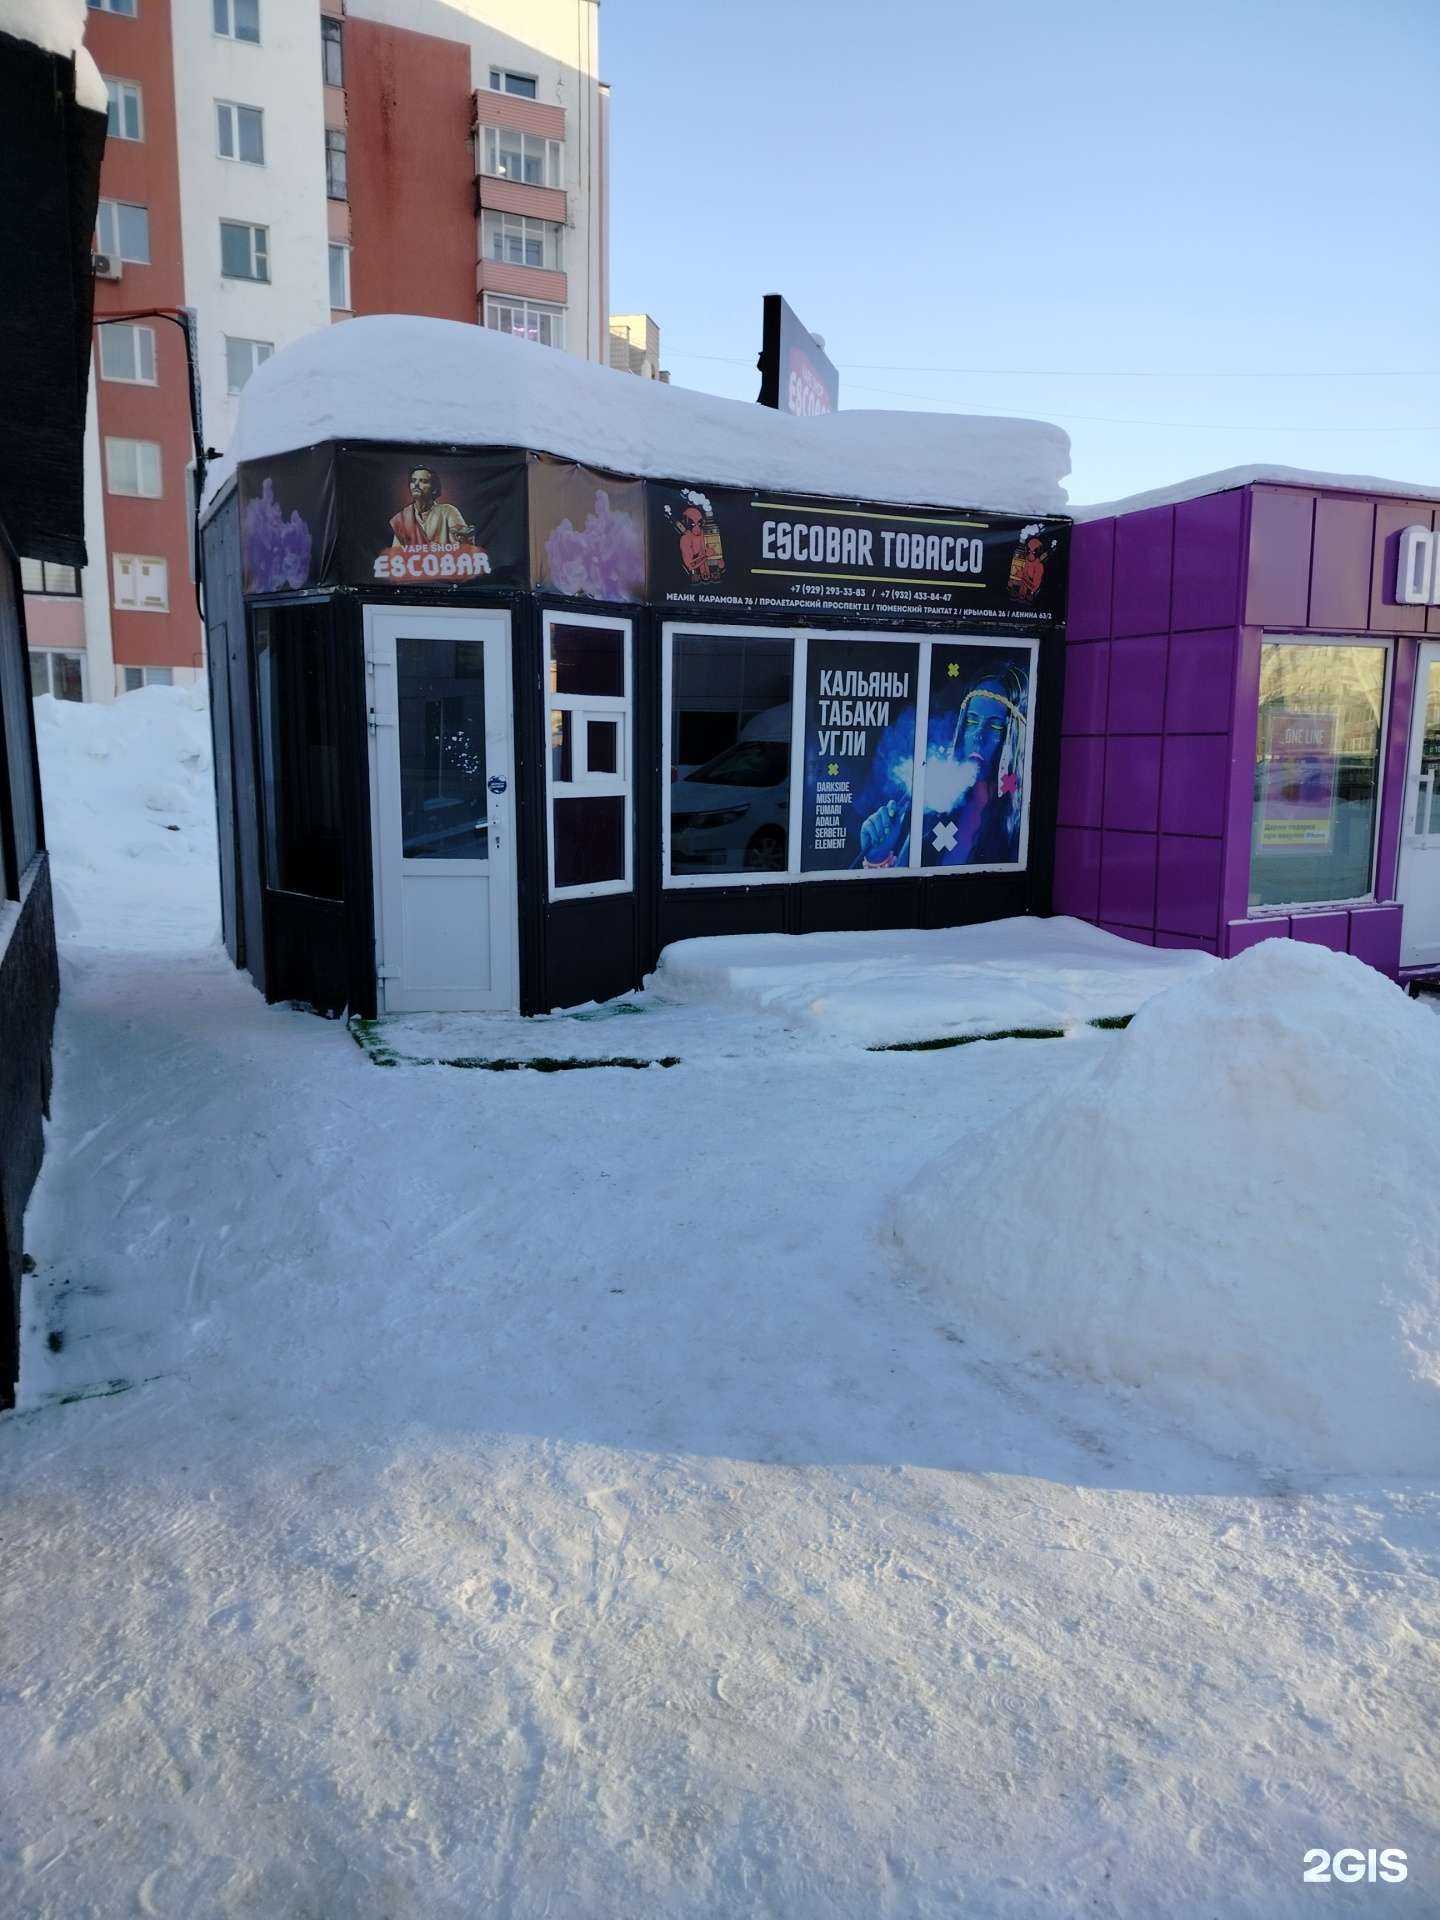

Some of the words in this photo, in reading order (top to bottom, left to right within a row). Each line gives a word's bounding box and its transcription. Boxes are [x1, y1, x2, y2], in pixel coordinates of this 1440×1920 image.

[401, 545, 428, 553] VAPE
[431, 543, 459, 553] SHOP
[762, 520, 873, 566] ESCOBAR
[880, 531, 984, 574] TOBACCO
[373, 552, 491, 578] ESCOBAR
[790, 584, 800, 593] +7
[802, 584, 824, 595] (929)
[880, 590, 890, 598] +7
[891, 589, 912, 600] (932)
[698, 595, 743, 605] КАРАМОВА
[744, 597, 753, 605] 76
[759, 598, 821, 608] ПРОЛЕТАРСКИЙ
[822, 601, 862, 610] ПРОСПЕКТ
[876, 604, 922, 613] ТЮМЕНСКИЙ
[963, 608, 997, 617] КРЫЛОВА
[819, 670, 909, 698] КАЛЬЯНЫ
[818, 700, 890, 726] ТАБАКИ
[818, 730, 866, 756] УГЛИ
[816, 781, 850, 792] DARKSIDE
[816, 793, 852, 804] MUSTHAVE
[815, 804, 842, 815] FUMARI
[815, 816, 840, 827] ADALIA
[814, 839, 846, 850] ELEMENT
